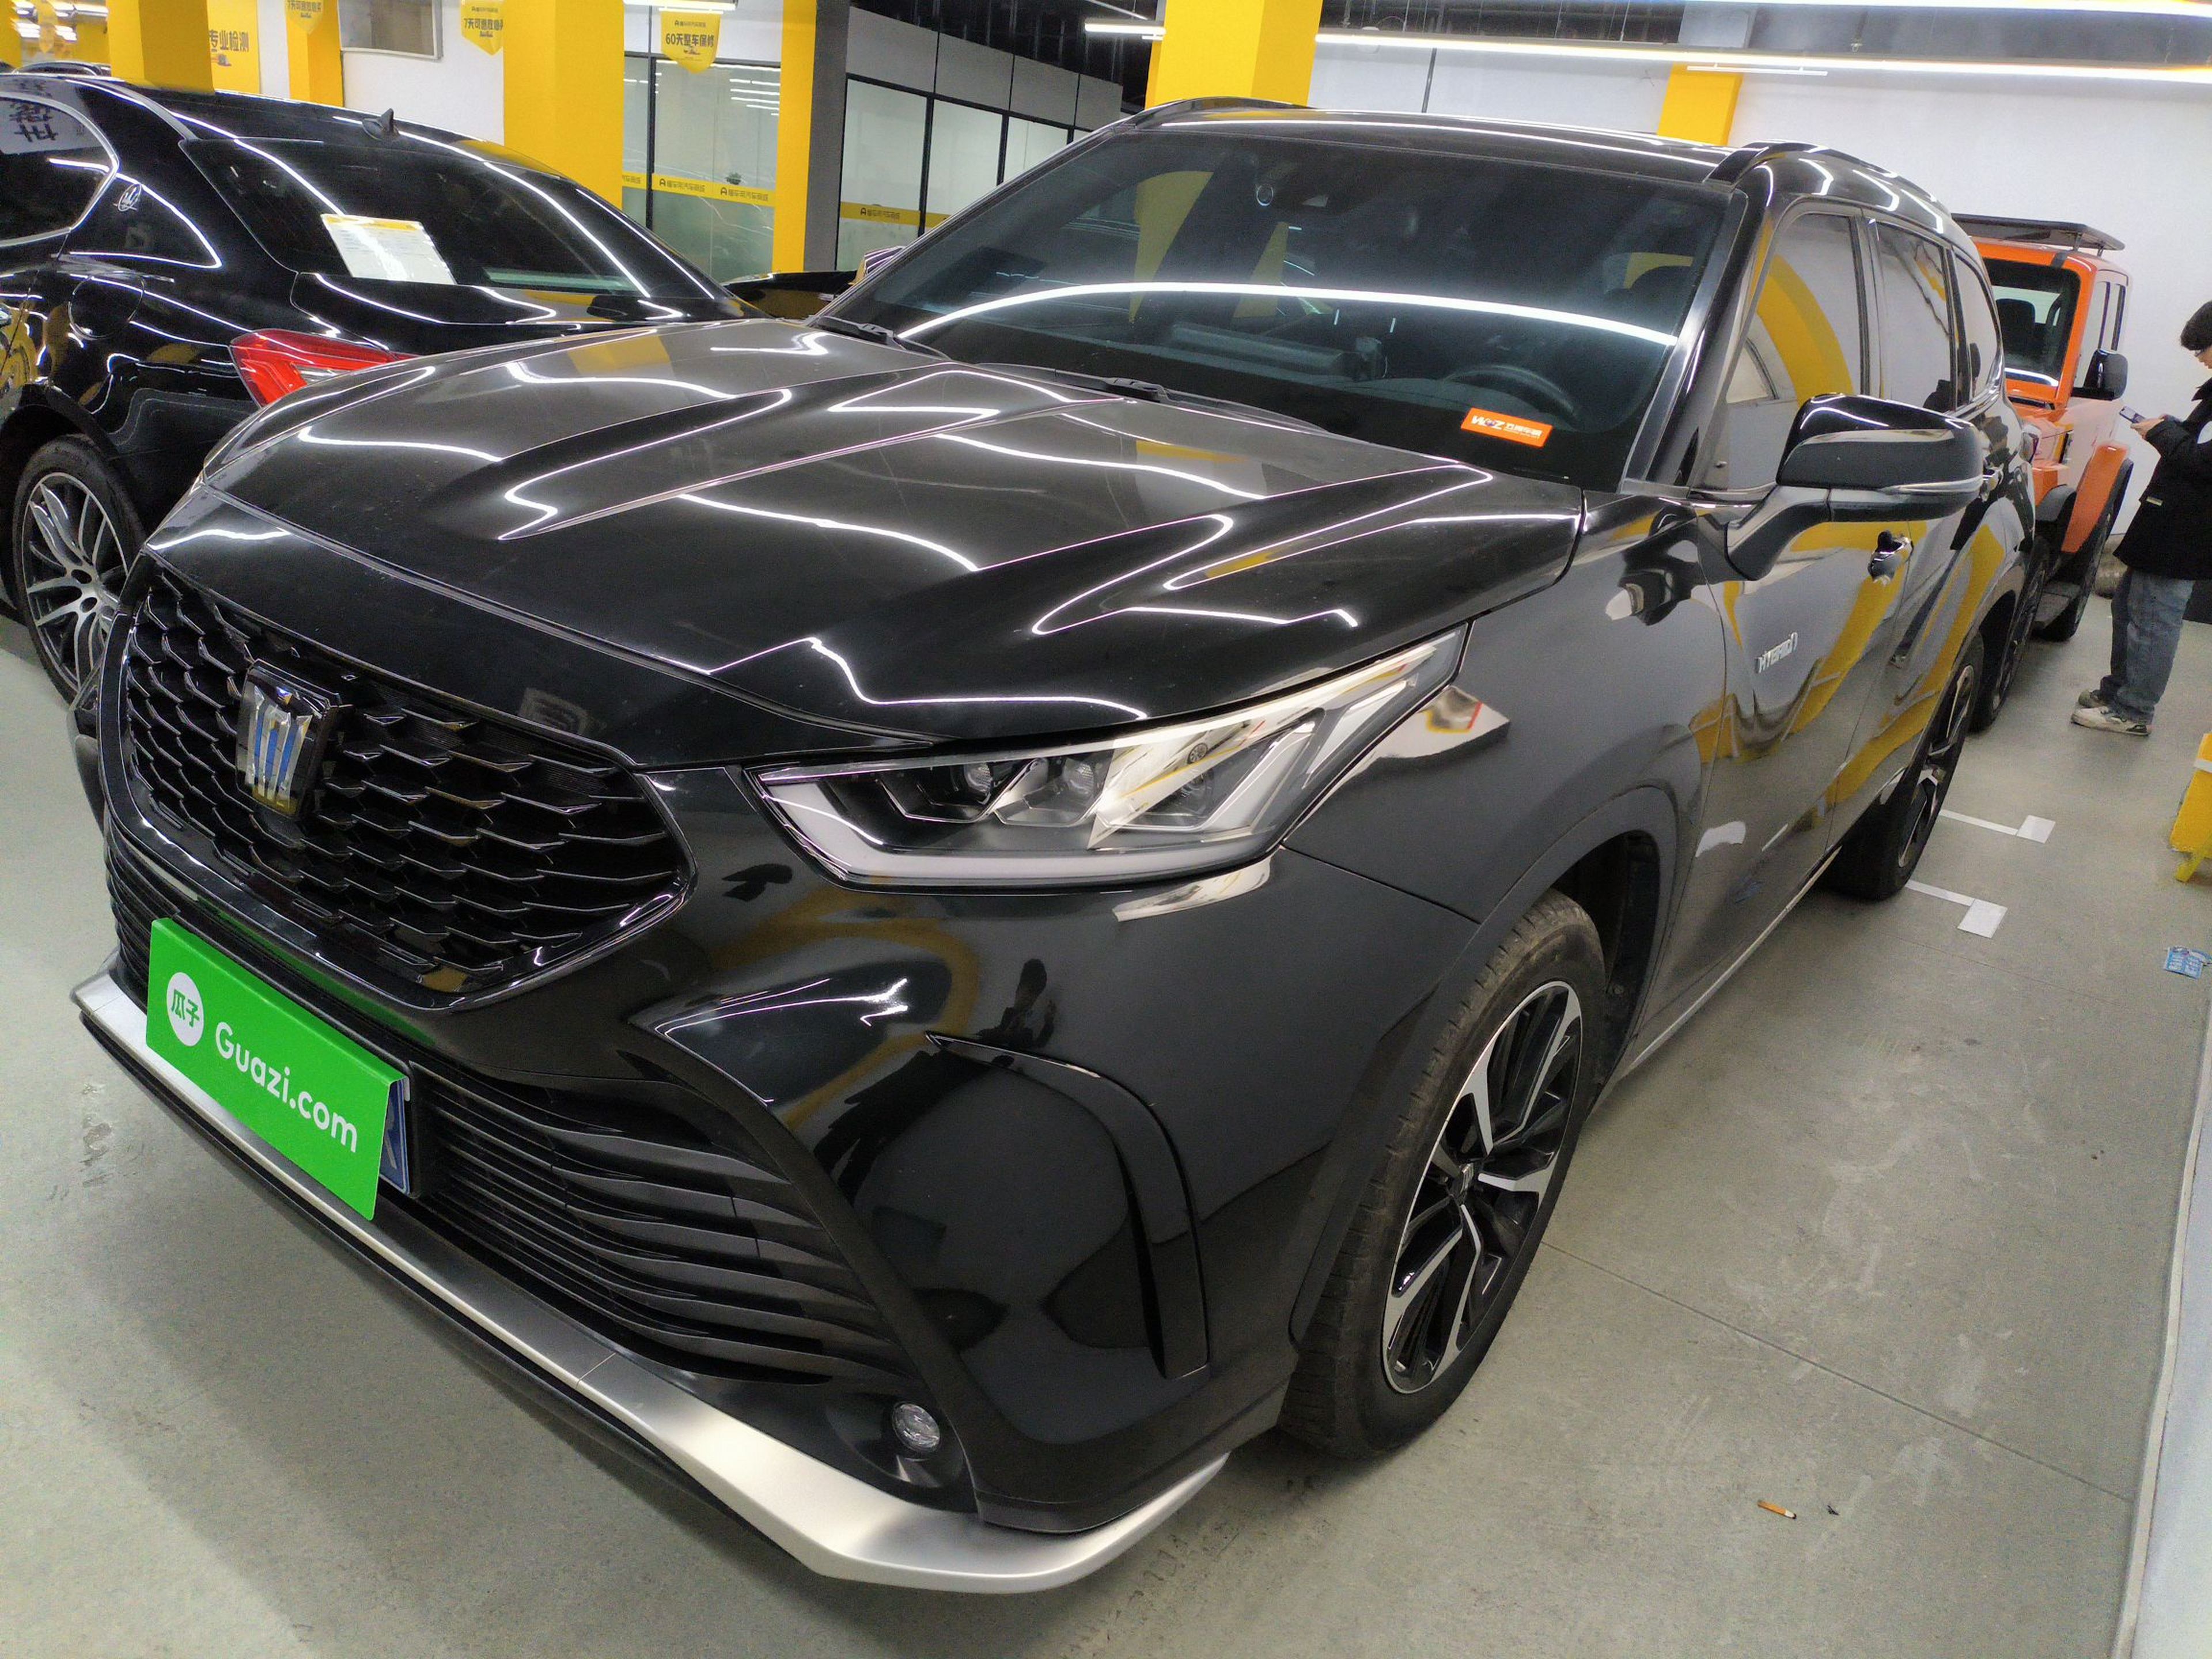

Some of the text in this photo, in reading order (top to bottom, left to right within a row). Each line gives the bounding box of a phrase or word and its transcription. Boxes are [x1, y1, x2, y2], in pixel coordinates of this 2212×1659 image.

[209, 30, 249, 52] 专业检测
[171, 988, 200, 1028] 瓜子
[215, 1021, 358, 1153] Guazi.com
